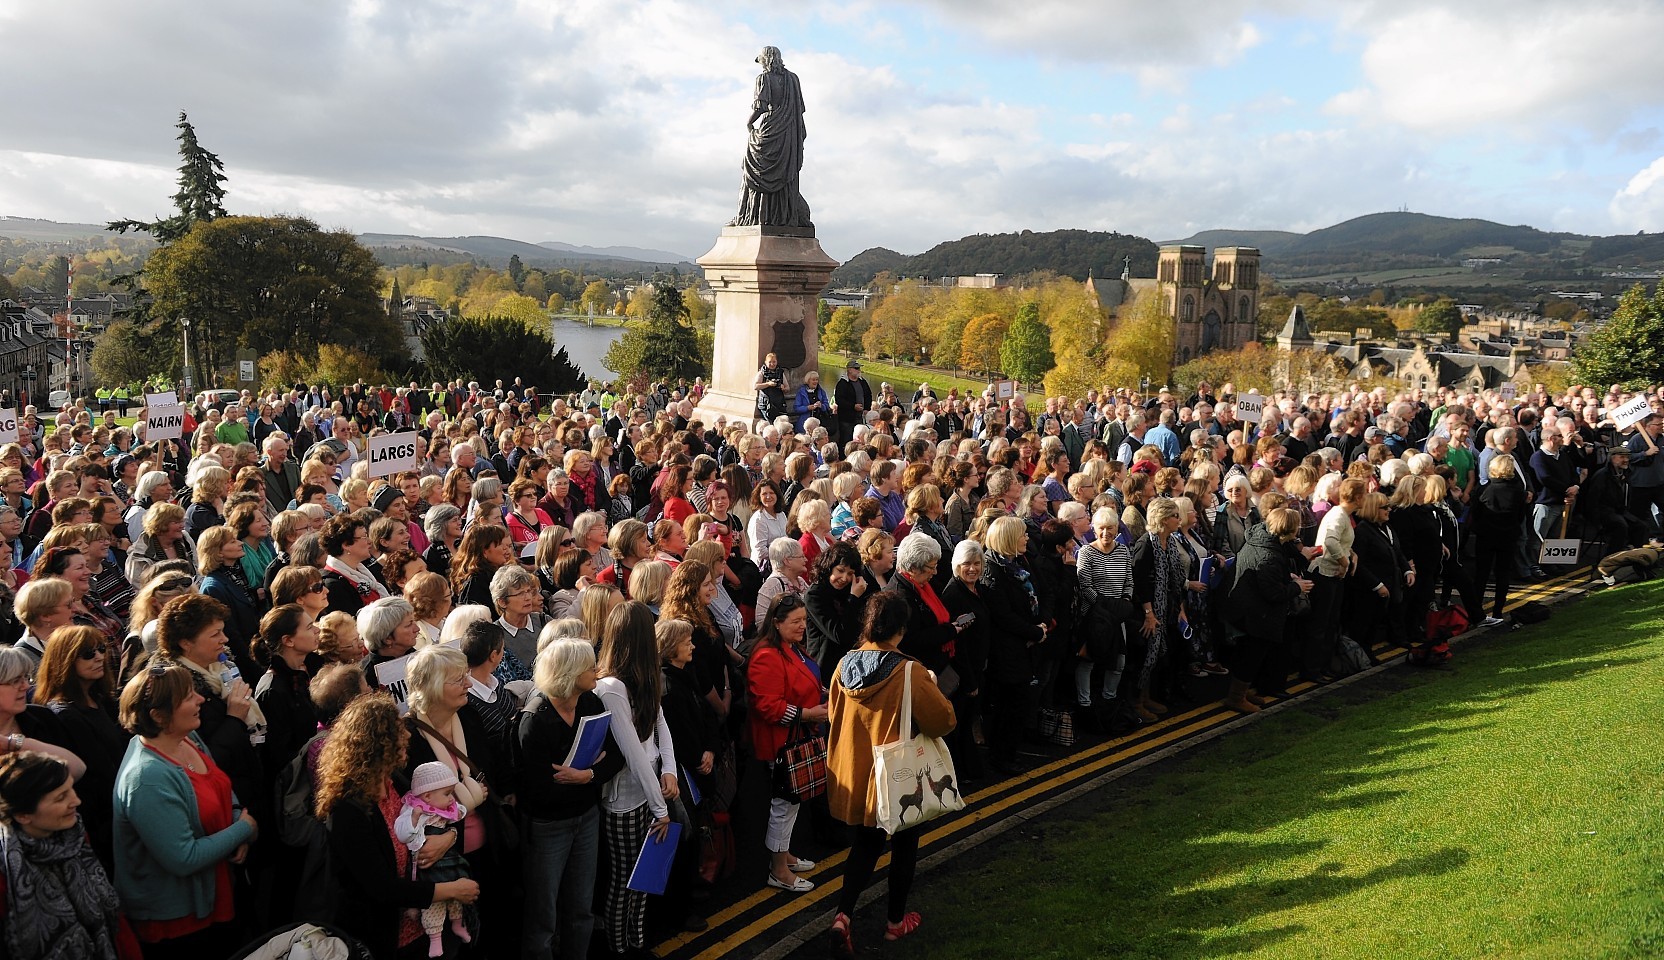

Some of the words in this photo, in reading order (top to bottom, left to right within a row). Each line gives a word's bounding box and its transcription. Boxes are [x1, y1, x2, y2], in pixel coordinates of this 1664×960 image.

[1239, 401, 1262, 414] OBAN
[1616, 401, 1647, 421] THUNG
[148, 415, 183, 429] NAIRN
[371, 443, 415, 464] LARGS
[1544, 547, 1577, 557] BACK
